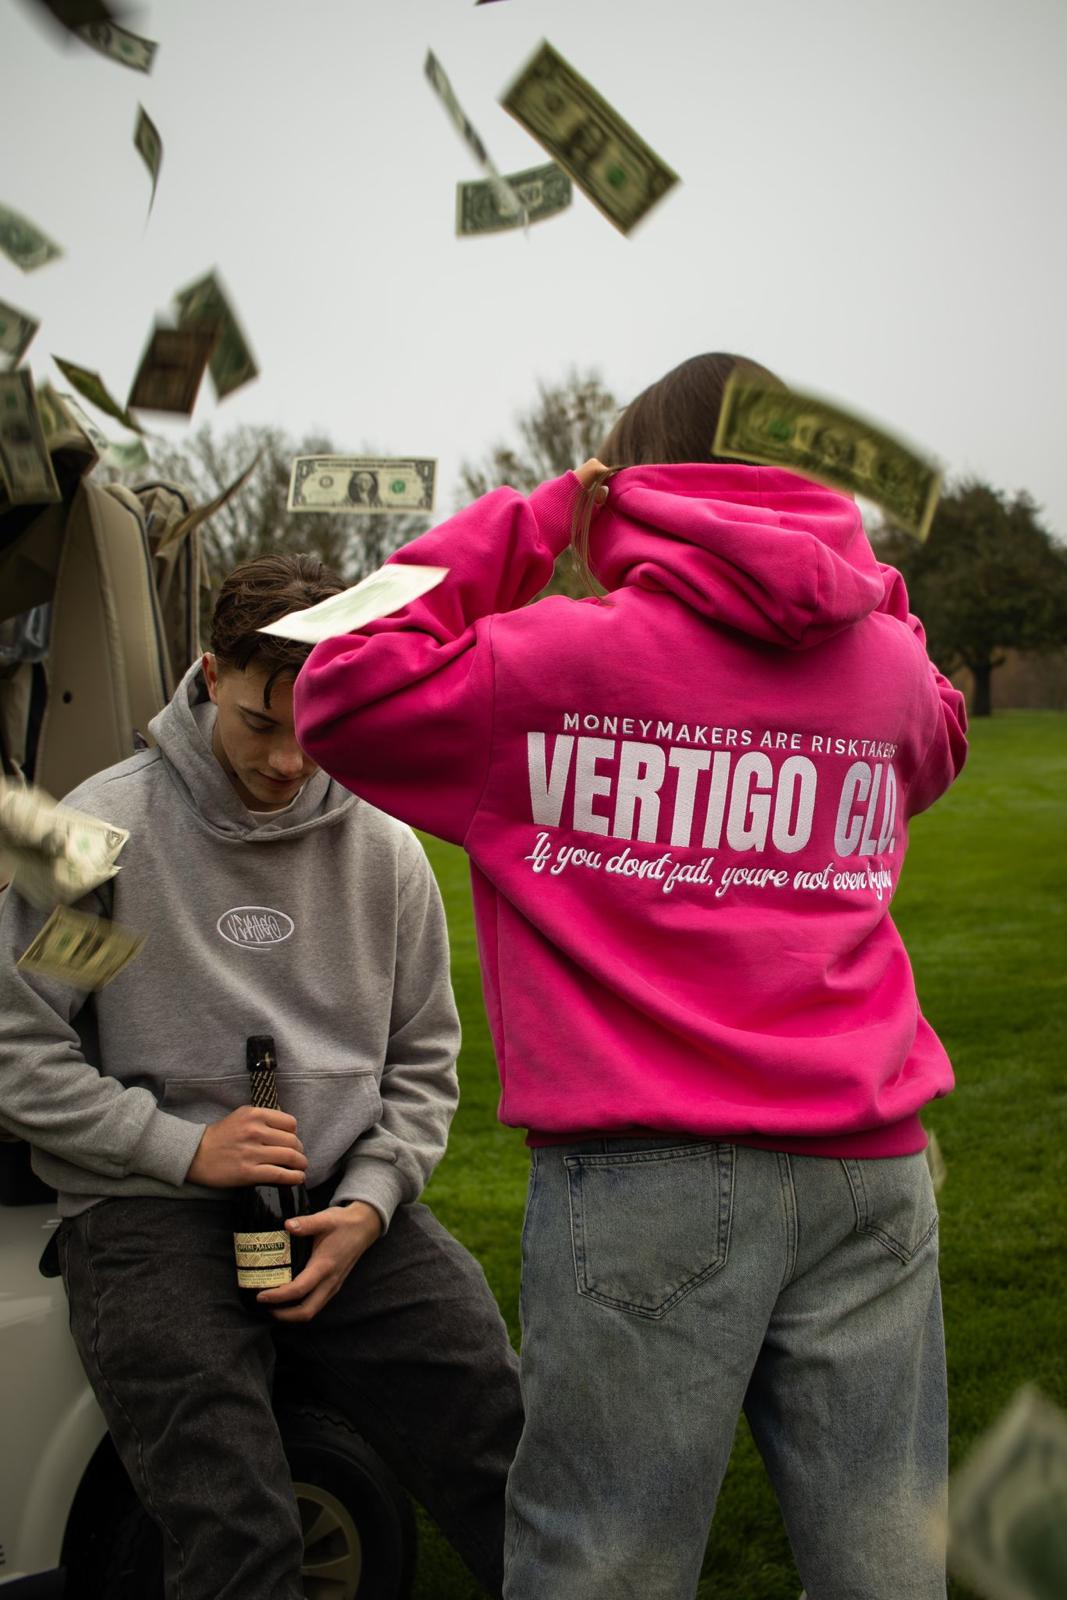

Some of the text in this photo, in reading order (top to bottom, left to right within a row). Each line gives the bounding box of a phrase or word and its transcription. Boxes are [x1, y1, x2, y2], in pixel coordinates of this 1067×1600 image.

[563, 713, 753, 746] MONEYMAKERS
[761, 730, 802, 750] ARE
[526, 731, 818, 854] VERTIGO
[524, 831, 552, 873] If
[550, 845, 602, 876] you
[605, 848, 673, 880] dont
[715, 866, 790, 898] youre
[793, 862, 834, 890] not
[832, 870, 867, 890] even
